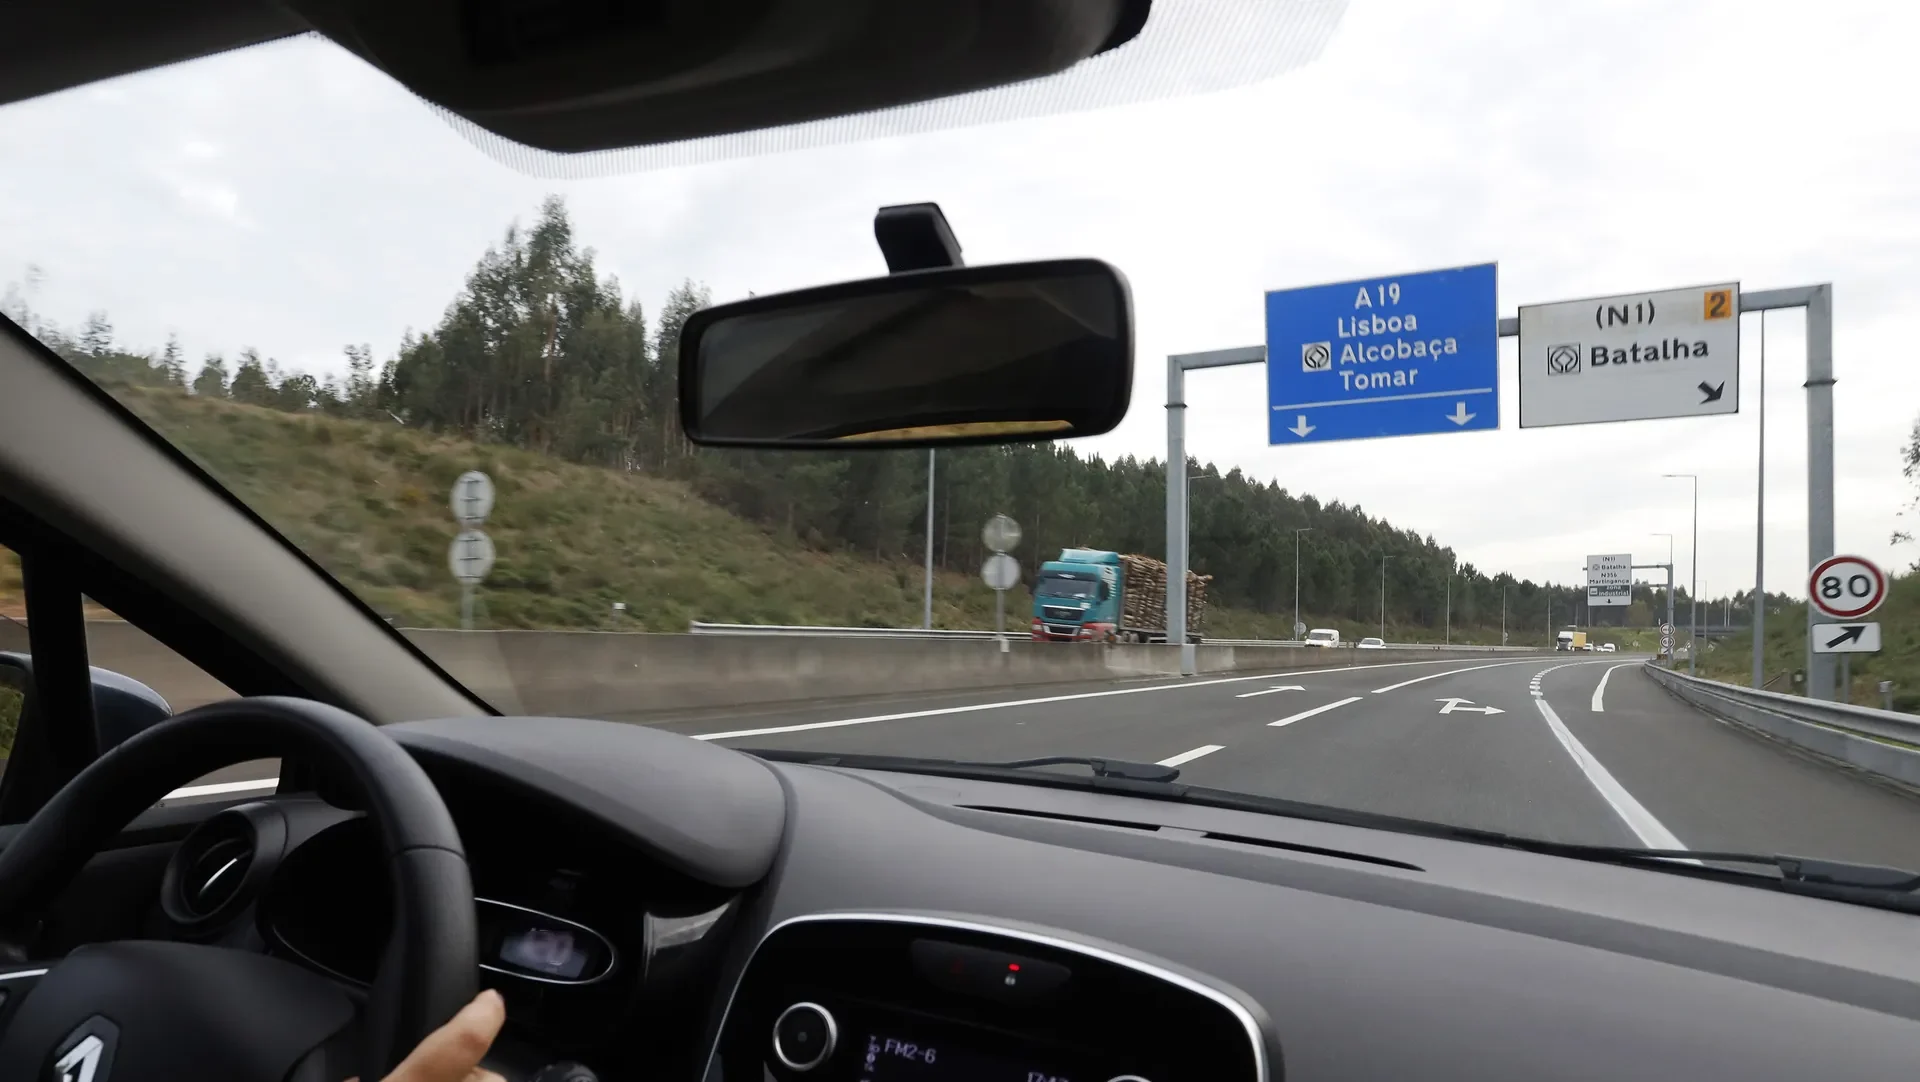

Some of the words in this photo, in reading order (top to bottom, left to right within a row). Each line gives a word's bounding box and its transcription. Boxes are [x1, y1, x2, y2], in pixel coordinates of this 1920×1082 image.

[1596, 299, 1655, 330] (N1)
[1709, 292, 1726, 317] 2
[1337, 313, 1418, 338] Lisboa
[1340, 335, 1458, 365] Alcobaça
[1590, 338, 1710, 368] Batalha
[1339, 368, 1419, 391] Tomar
[1822, 574, 1871, 599] 80
[884, 1038, 937, 1064] FM2-6
